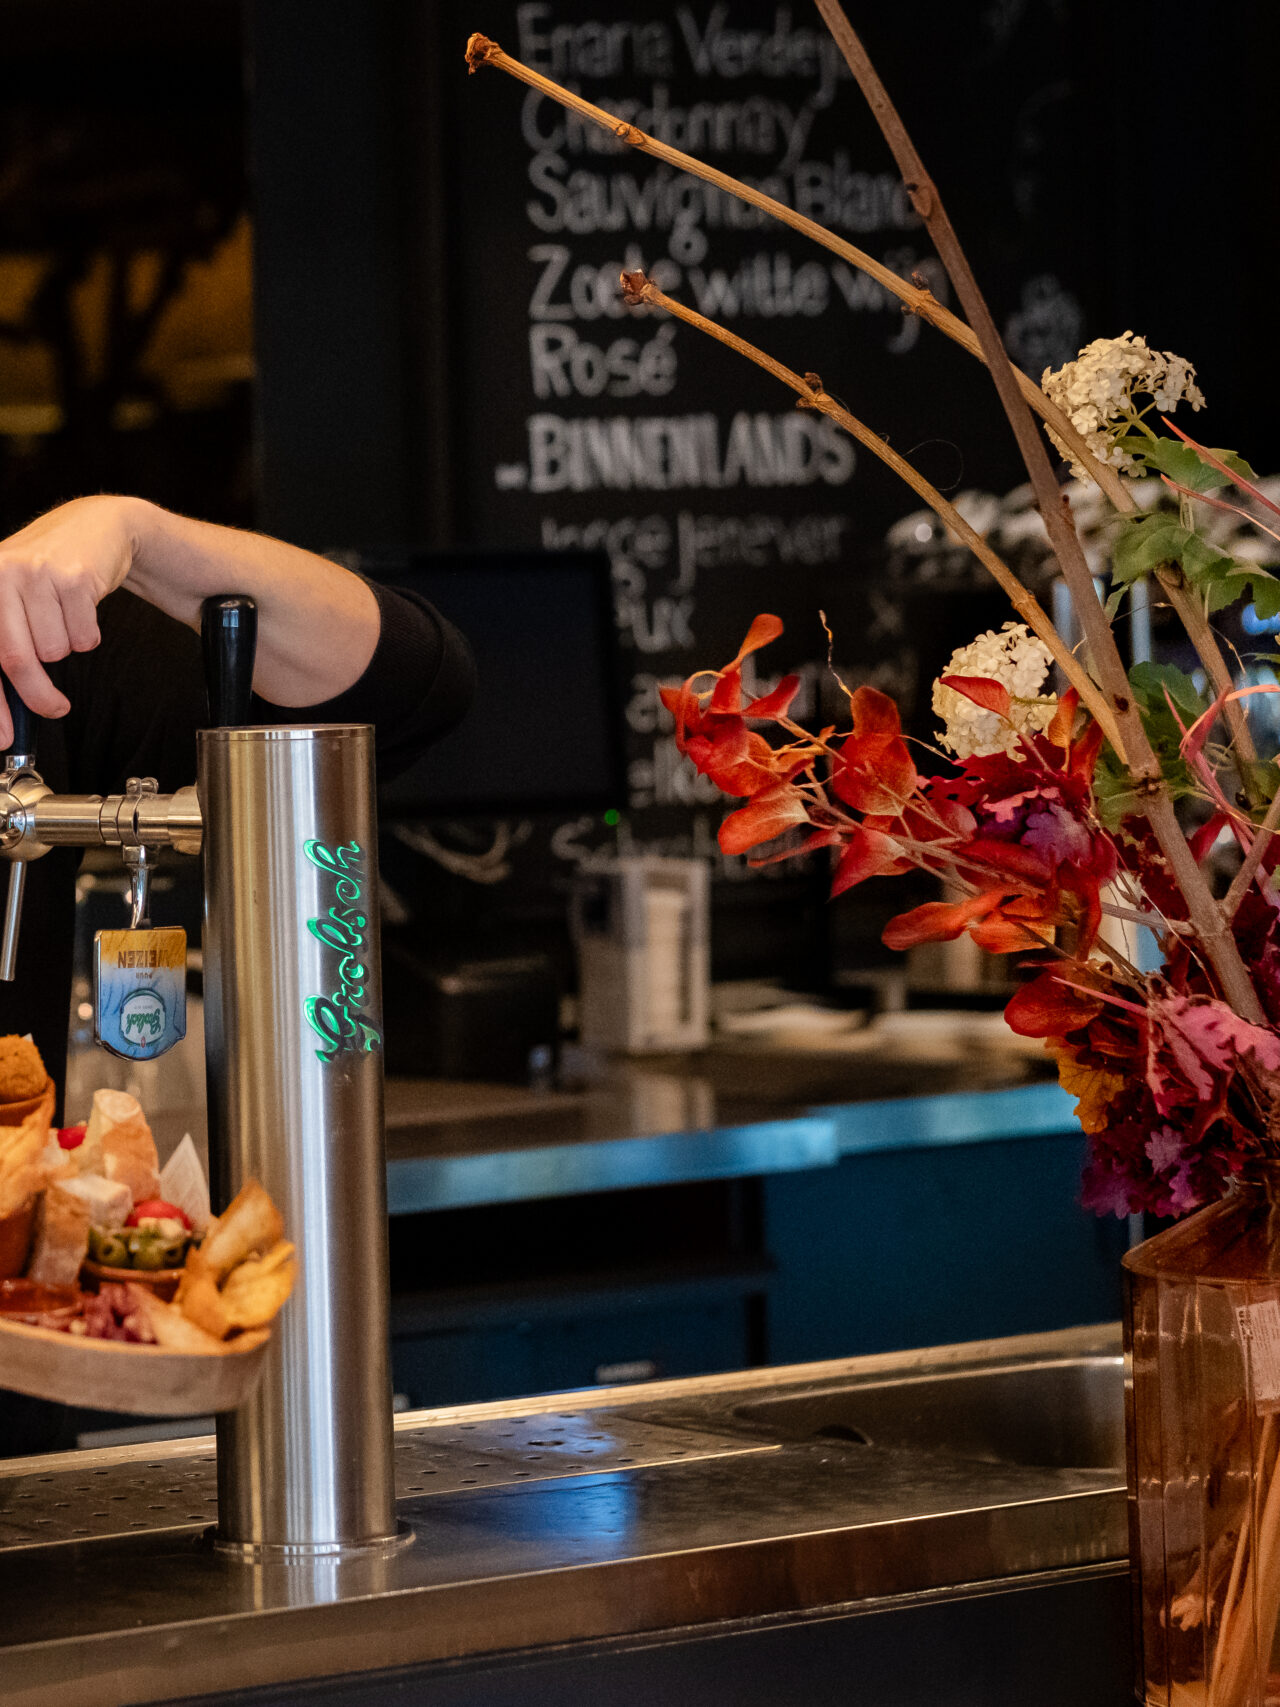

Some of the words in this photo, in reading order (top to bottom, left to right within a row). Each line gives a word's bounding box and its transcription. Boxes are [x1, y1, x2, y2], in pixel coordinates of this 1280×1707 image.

[677, 2, 854, 108] Verdej
[528, 322, 678, 398] Rosé
[528, 411, 857, 492] BINNENLANDS
